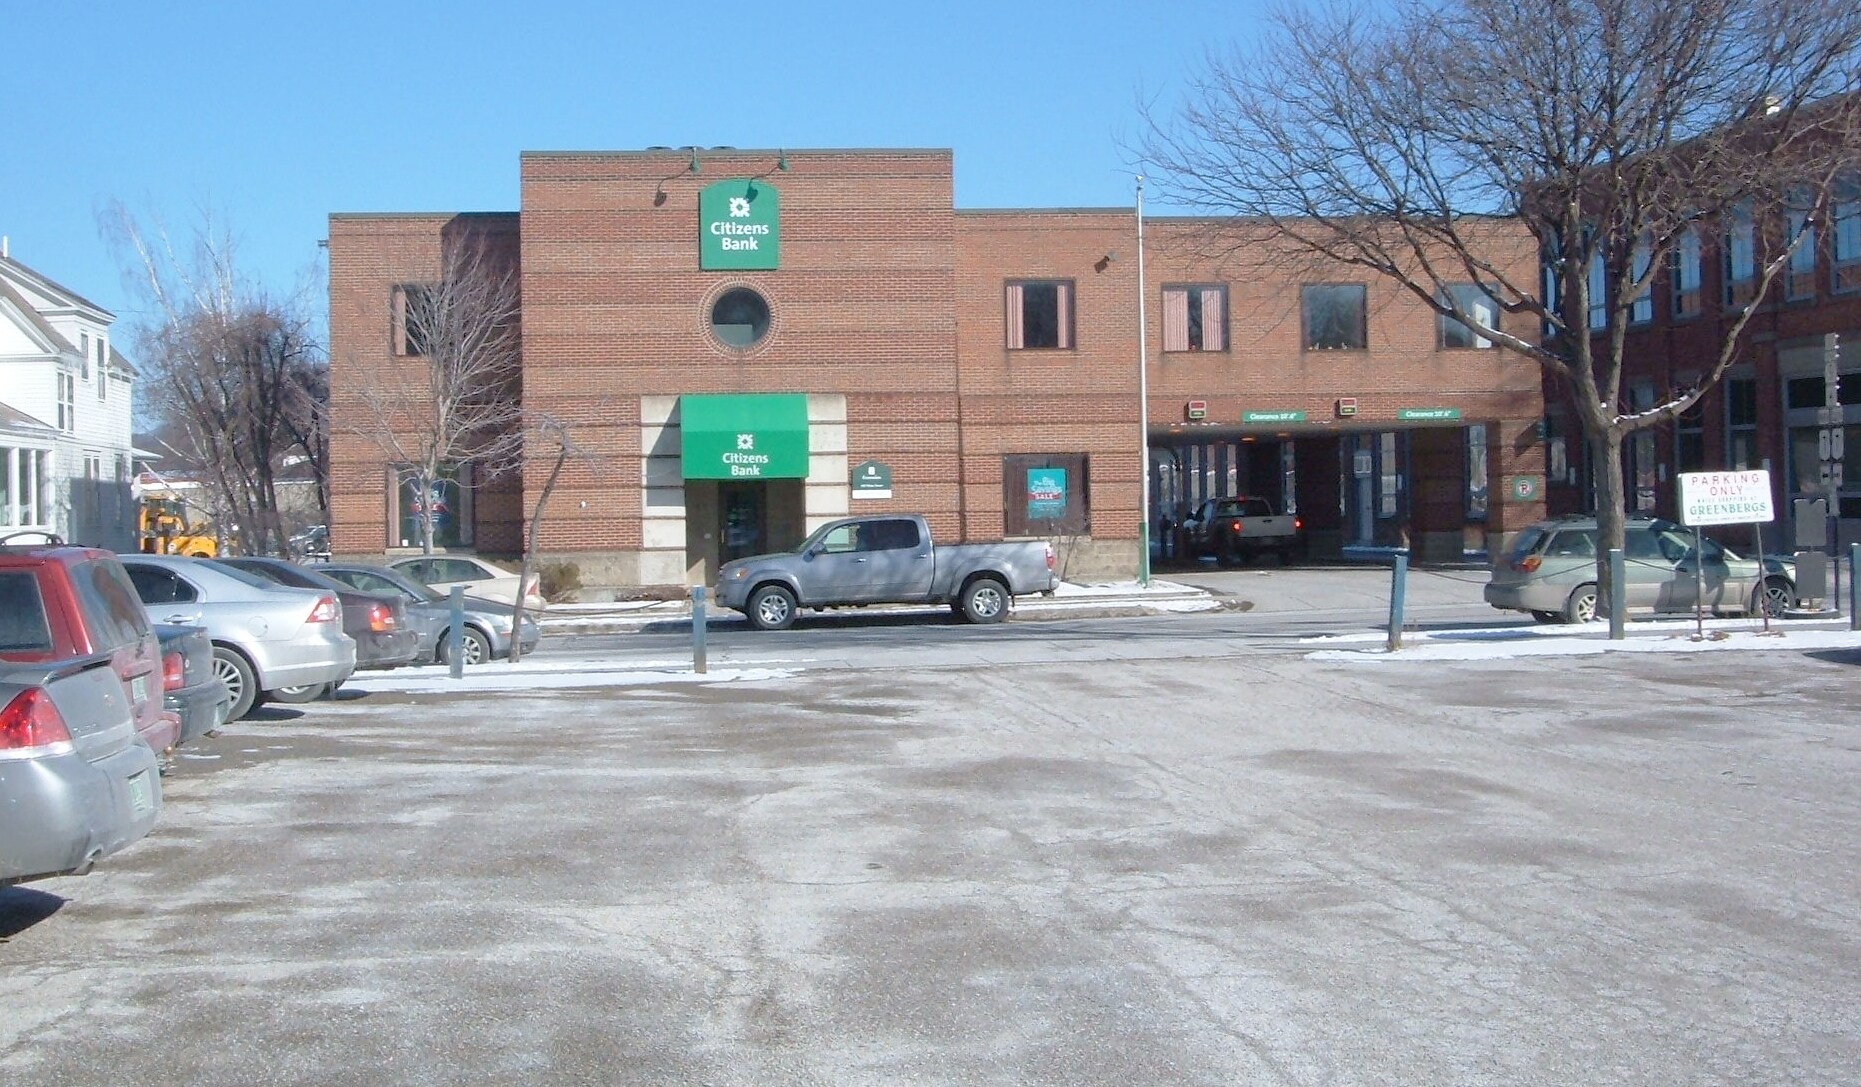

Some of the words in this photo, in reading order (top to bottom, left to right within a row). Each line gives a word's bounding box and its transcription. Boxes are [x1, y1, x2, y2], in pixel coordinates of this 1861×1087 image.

[710, 221, 769, 235] Citizens
[721, 236, 759, 250] Bank
[722, 452, 769, 464] Citizens
[731, 464, 760, 476] Bank
[1692, 473, 1759, 486] PARKING
[1710, 486, 1743, 496] ONLY
[1690, 502, 1766, 515] GREENBERGS
